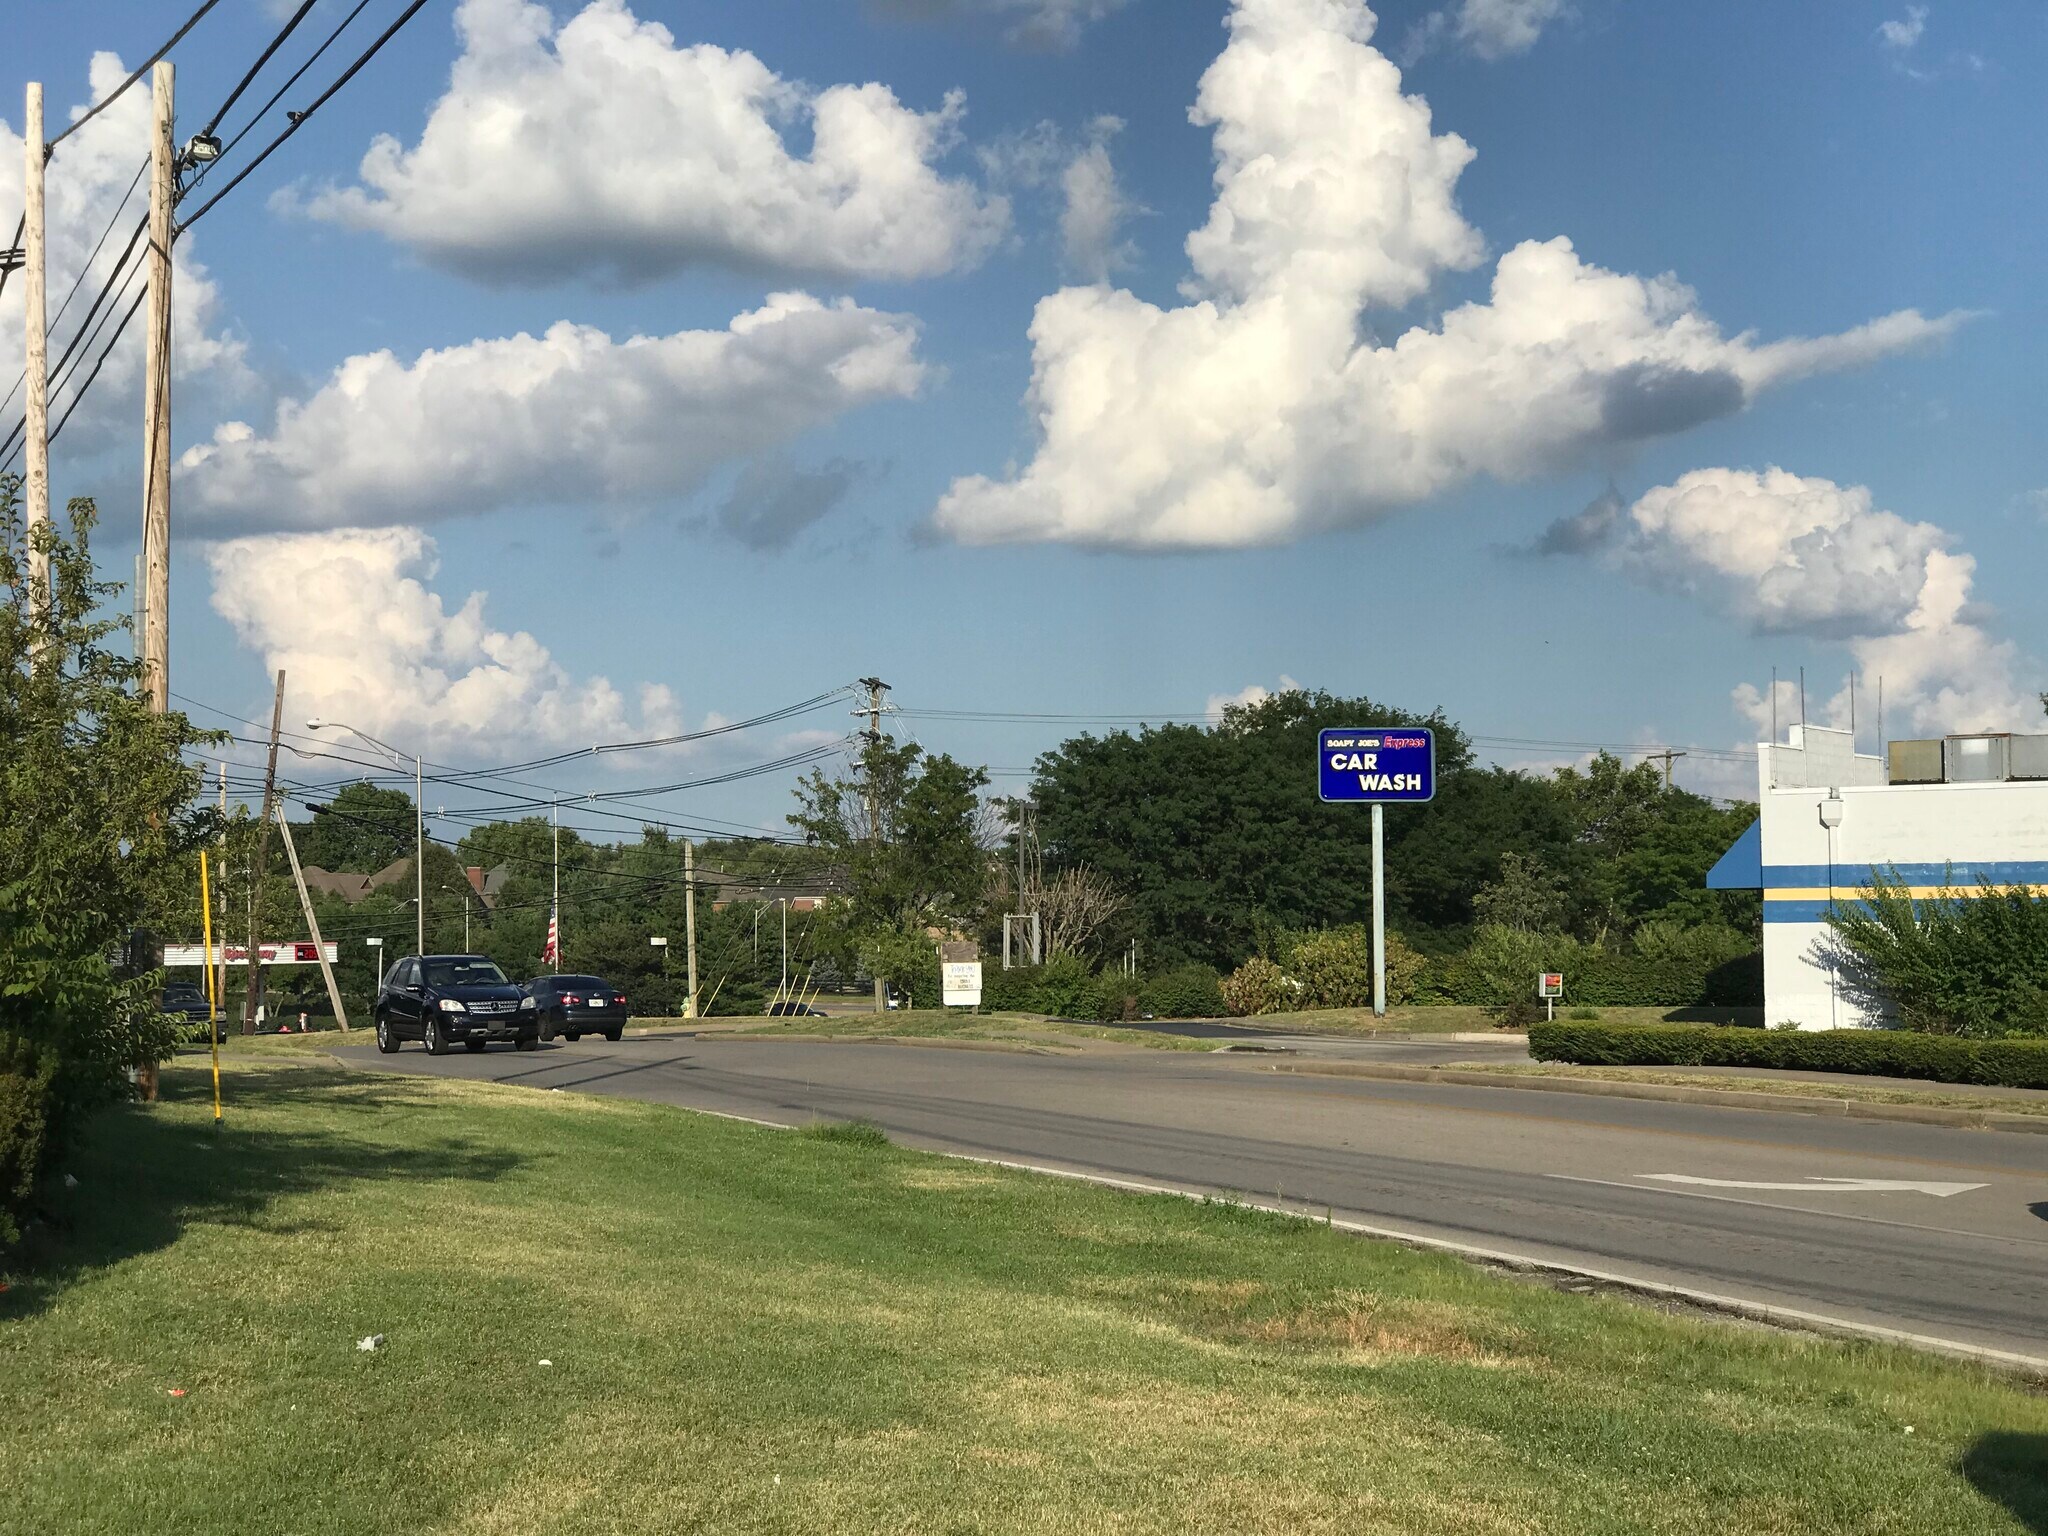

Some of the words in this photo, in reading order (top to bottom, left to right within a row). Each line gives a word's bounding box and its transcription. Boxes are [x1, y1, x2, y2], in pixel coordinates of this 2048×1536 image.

[1327, 739, 1354, 747] SOAPY
[1383, 736, 1426, 750] Express
[1330, 753, 1378, 770] CAR
[1359, 773, 1421, 791] WASH
